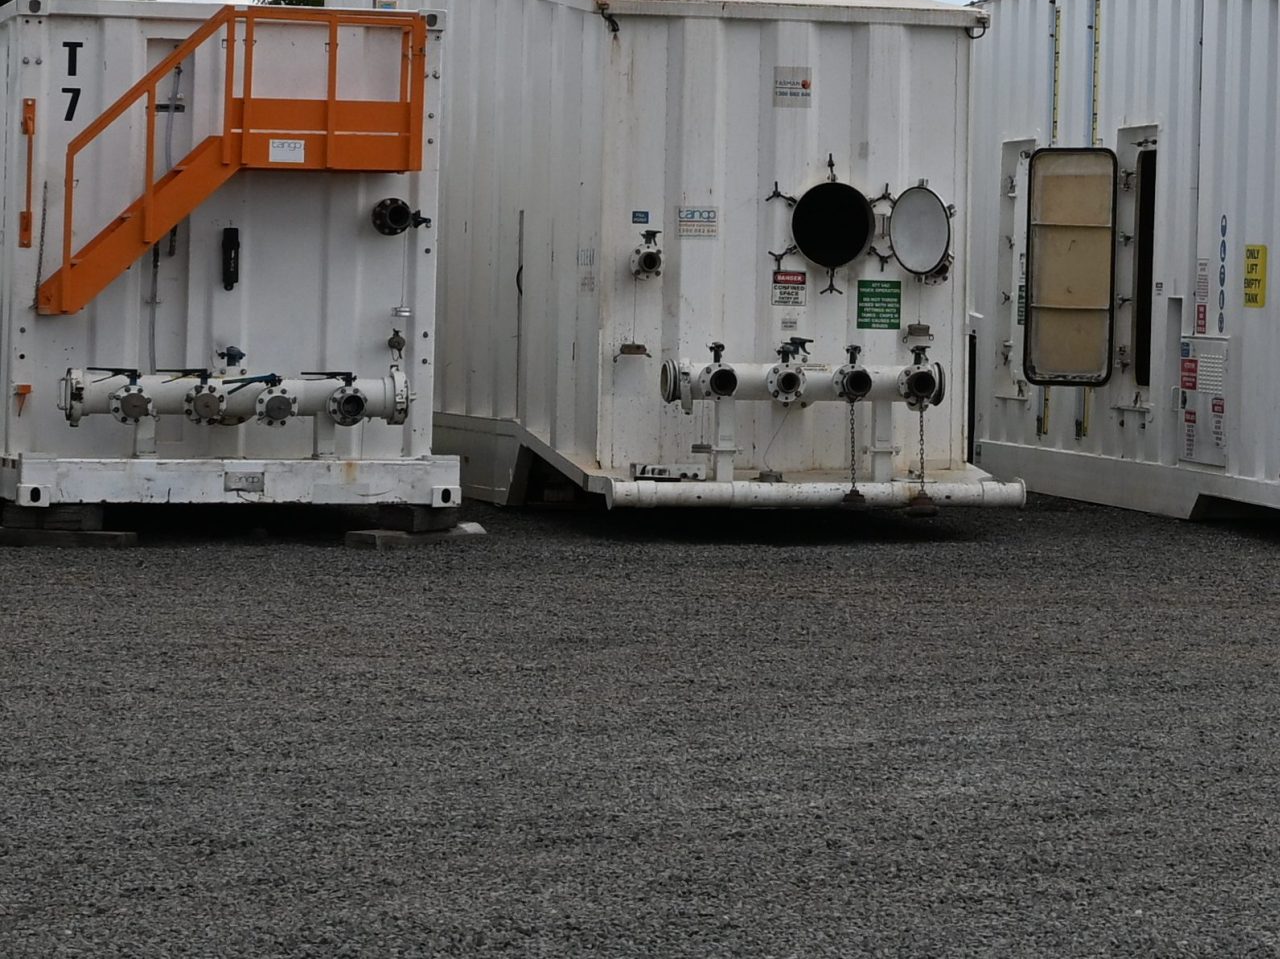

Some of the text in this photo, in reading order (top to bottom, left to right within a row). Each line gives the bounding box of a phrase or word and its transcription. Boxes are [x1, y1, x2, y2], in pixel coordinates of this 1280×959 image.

[62, 41, 83, 76] T
[61, 87, 82, 122] 7
[1246, 248, 1260, 260] ONLY
[1246, 263, 1258, 274] LIFT
[1244, 292, 1258, 305] TANK
